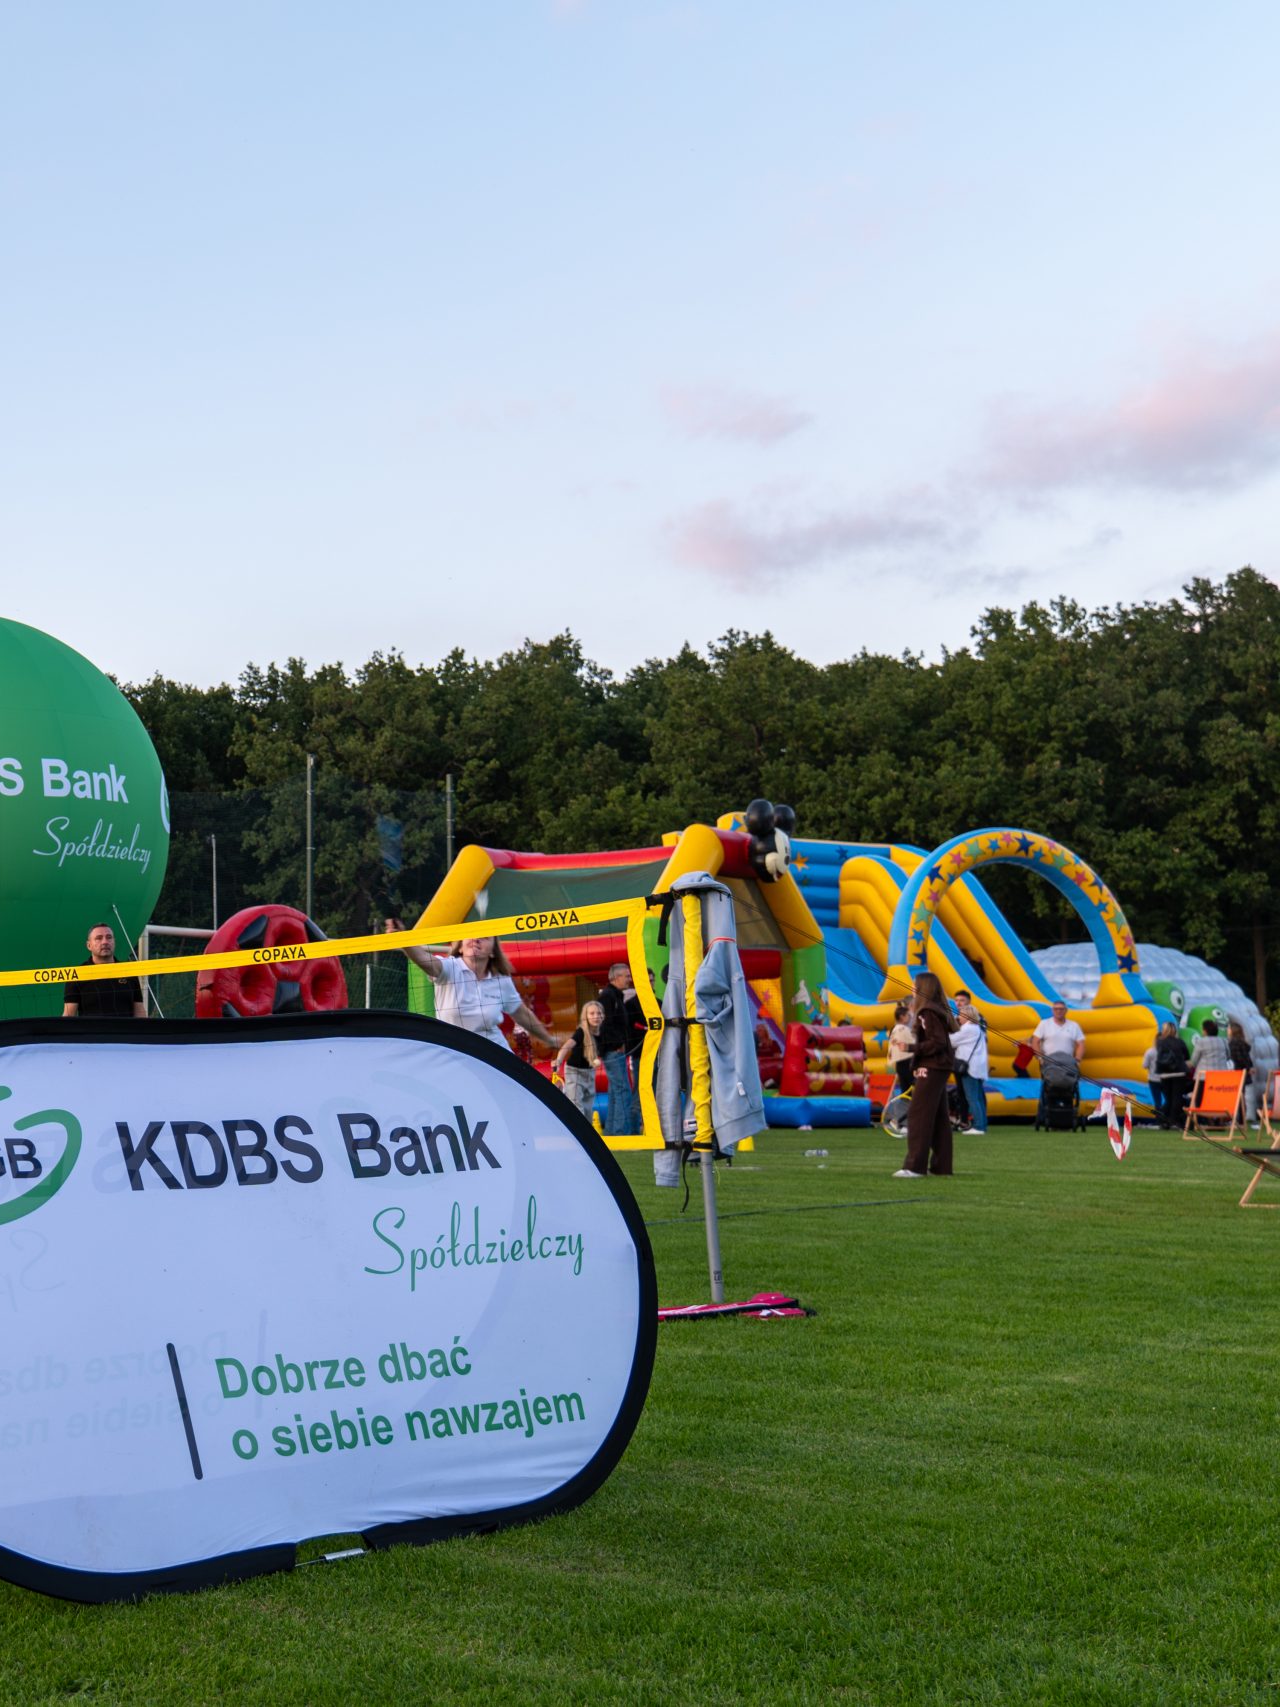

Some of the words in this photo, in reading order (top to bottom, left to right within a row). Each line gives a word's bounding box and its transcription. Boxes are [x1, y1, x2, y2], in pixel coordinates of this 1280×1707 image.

[41, 758, 129, 804] Bank
[33, 816, 151, 874] Spółdzielczy
[515, 910, 580, 931] COPAYA
[34, 968, 79, 983] COPAYA
[253, 946, 307, 963] COPAYA
[115, 1115, 324, 1191] KDBS
[337, 1105, 502, 1180] Bank
[364, 1195, 585, 1292] Spółdzielczy
[215, 1353, 366, 1399] Dobrze
[378, 1335, 472, 1384] dbać
[232, 1428, 259, 1460] o
[272, 1406, 394, 1458] siebie
[405, 1388, 586, 1442] nawzajem
